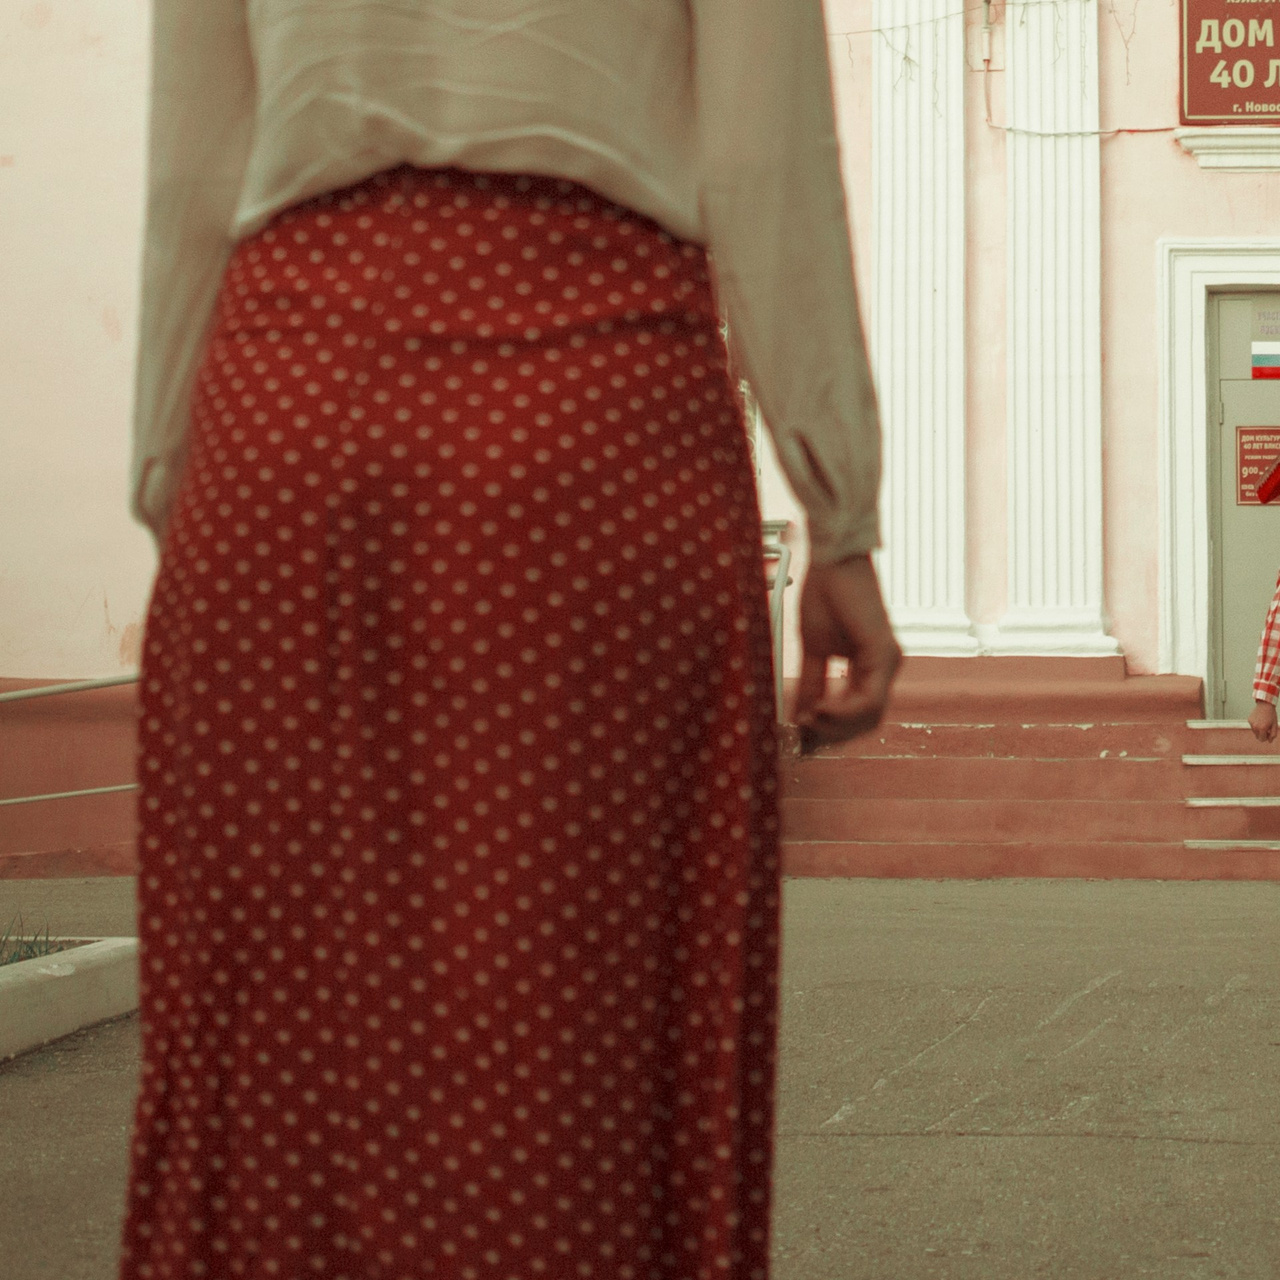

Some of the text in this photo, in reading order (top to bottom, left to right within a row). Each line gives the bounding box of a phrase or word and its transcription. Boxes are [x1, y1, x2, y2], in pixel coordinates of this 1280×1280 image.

[1196, 19, 1274, 53] ДОМ
[1209, 59, 1255, 89] 40
[1233, 104, 1242, 113] г.
